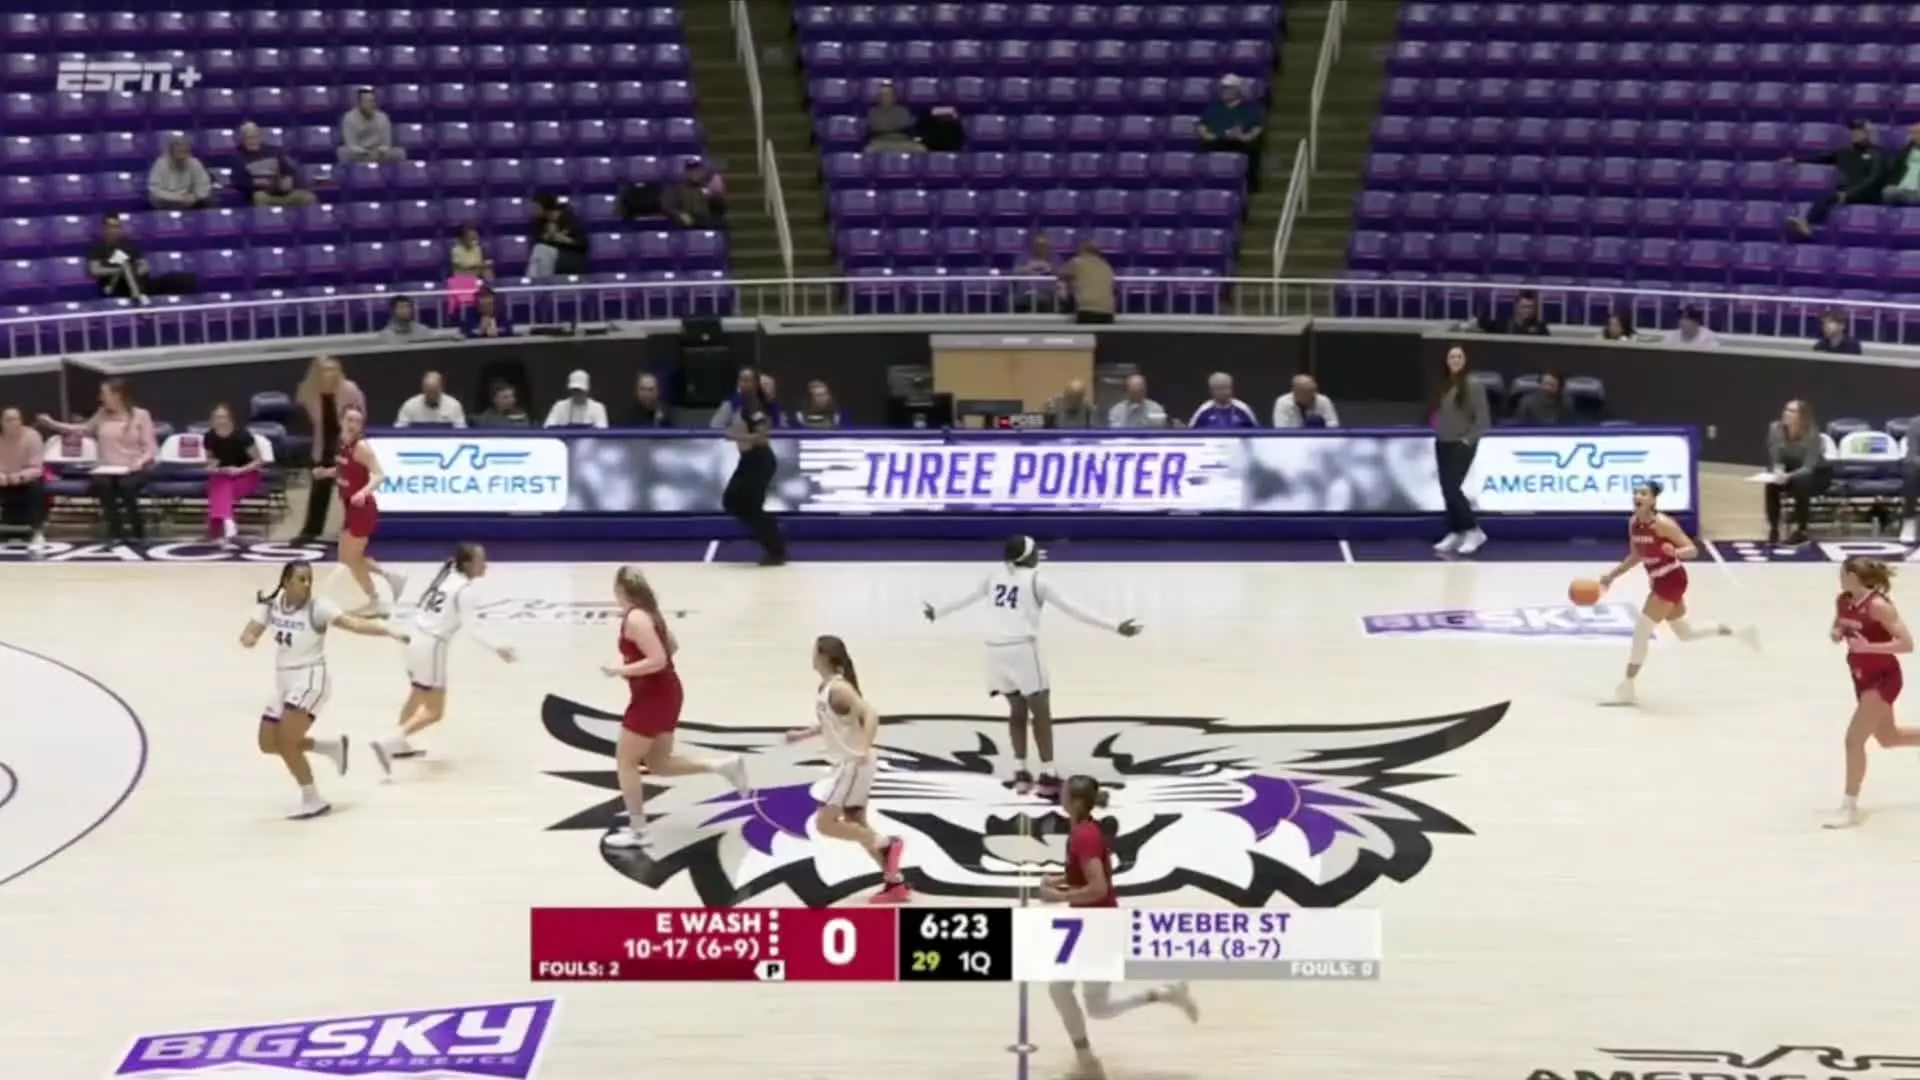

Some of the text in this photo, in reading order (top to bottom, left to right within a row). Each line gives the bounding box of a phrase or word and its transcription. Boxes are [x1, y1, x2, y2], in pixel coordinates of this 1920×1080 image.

[865, 452, 1187, 497] THREE POINTER
[1481, 474, 1600, 493] AMERICA
[380, 475, 561, 494] MERICA FIRST
[995, 583, 1019, 609] 24
[274, 630, 292, 648] 44
